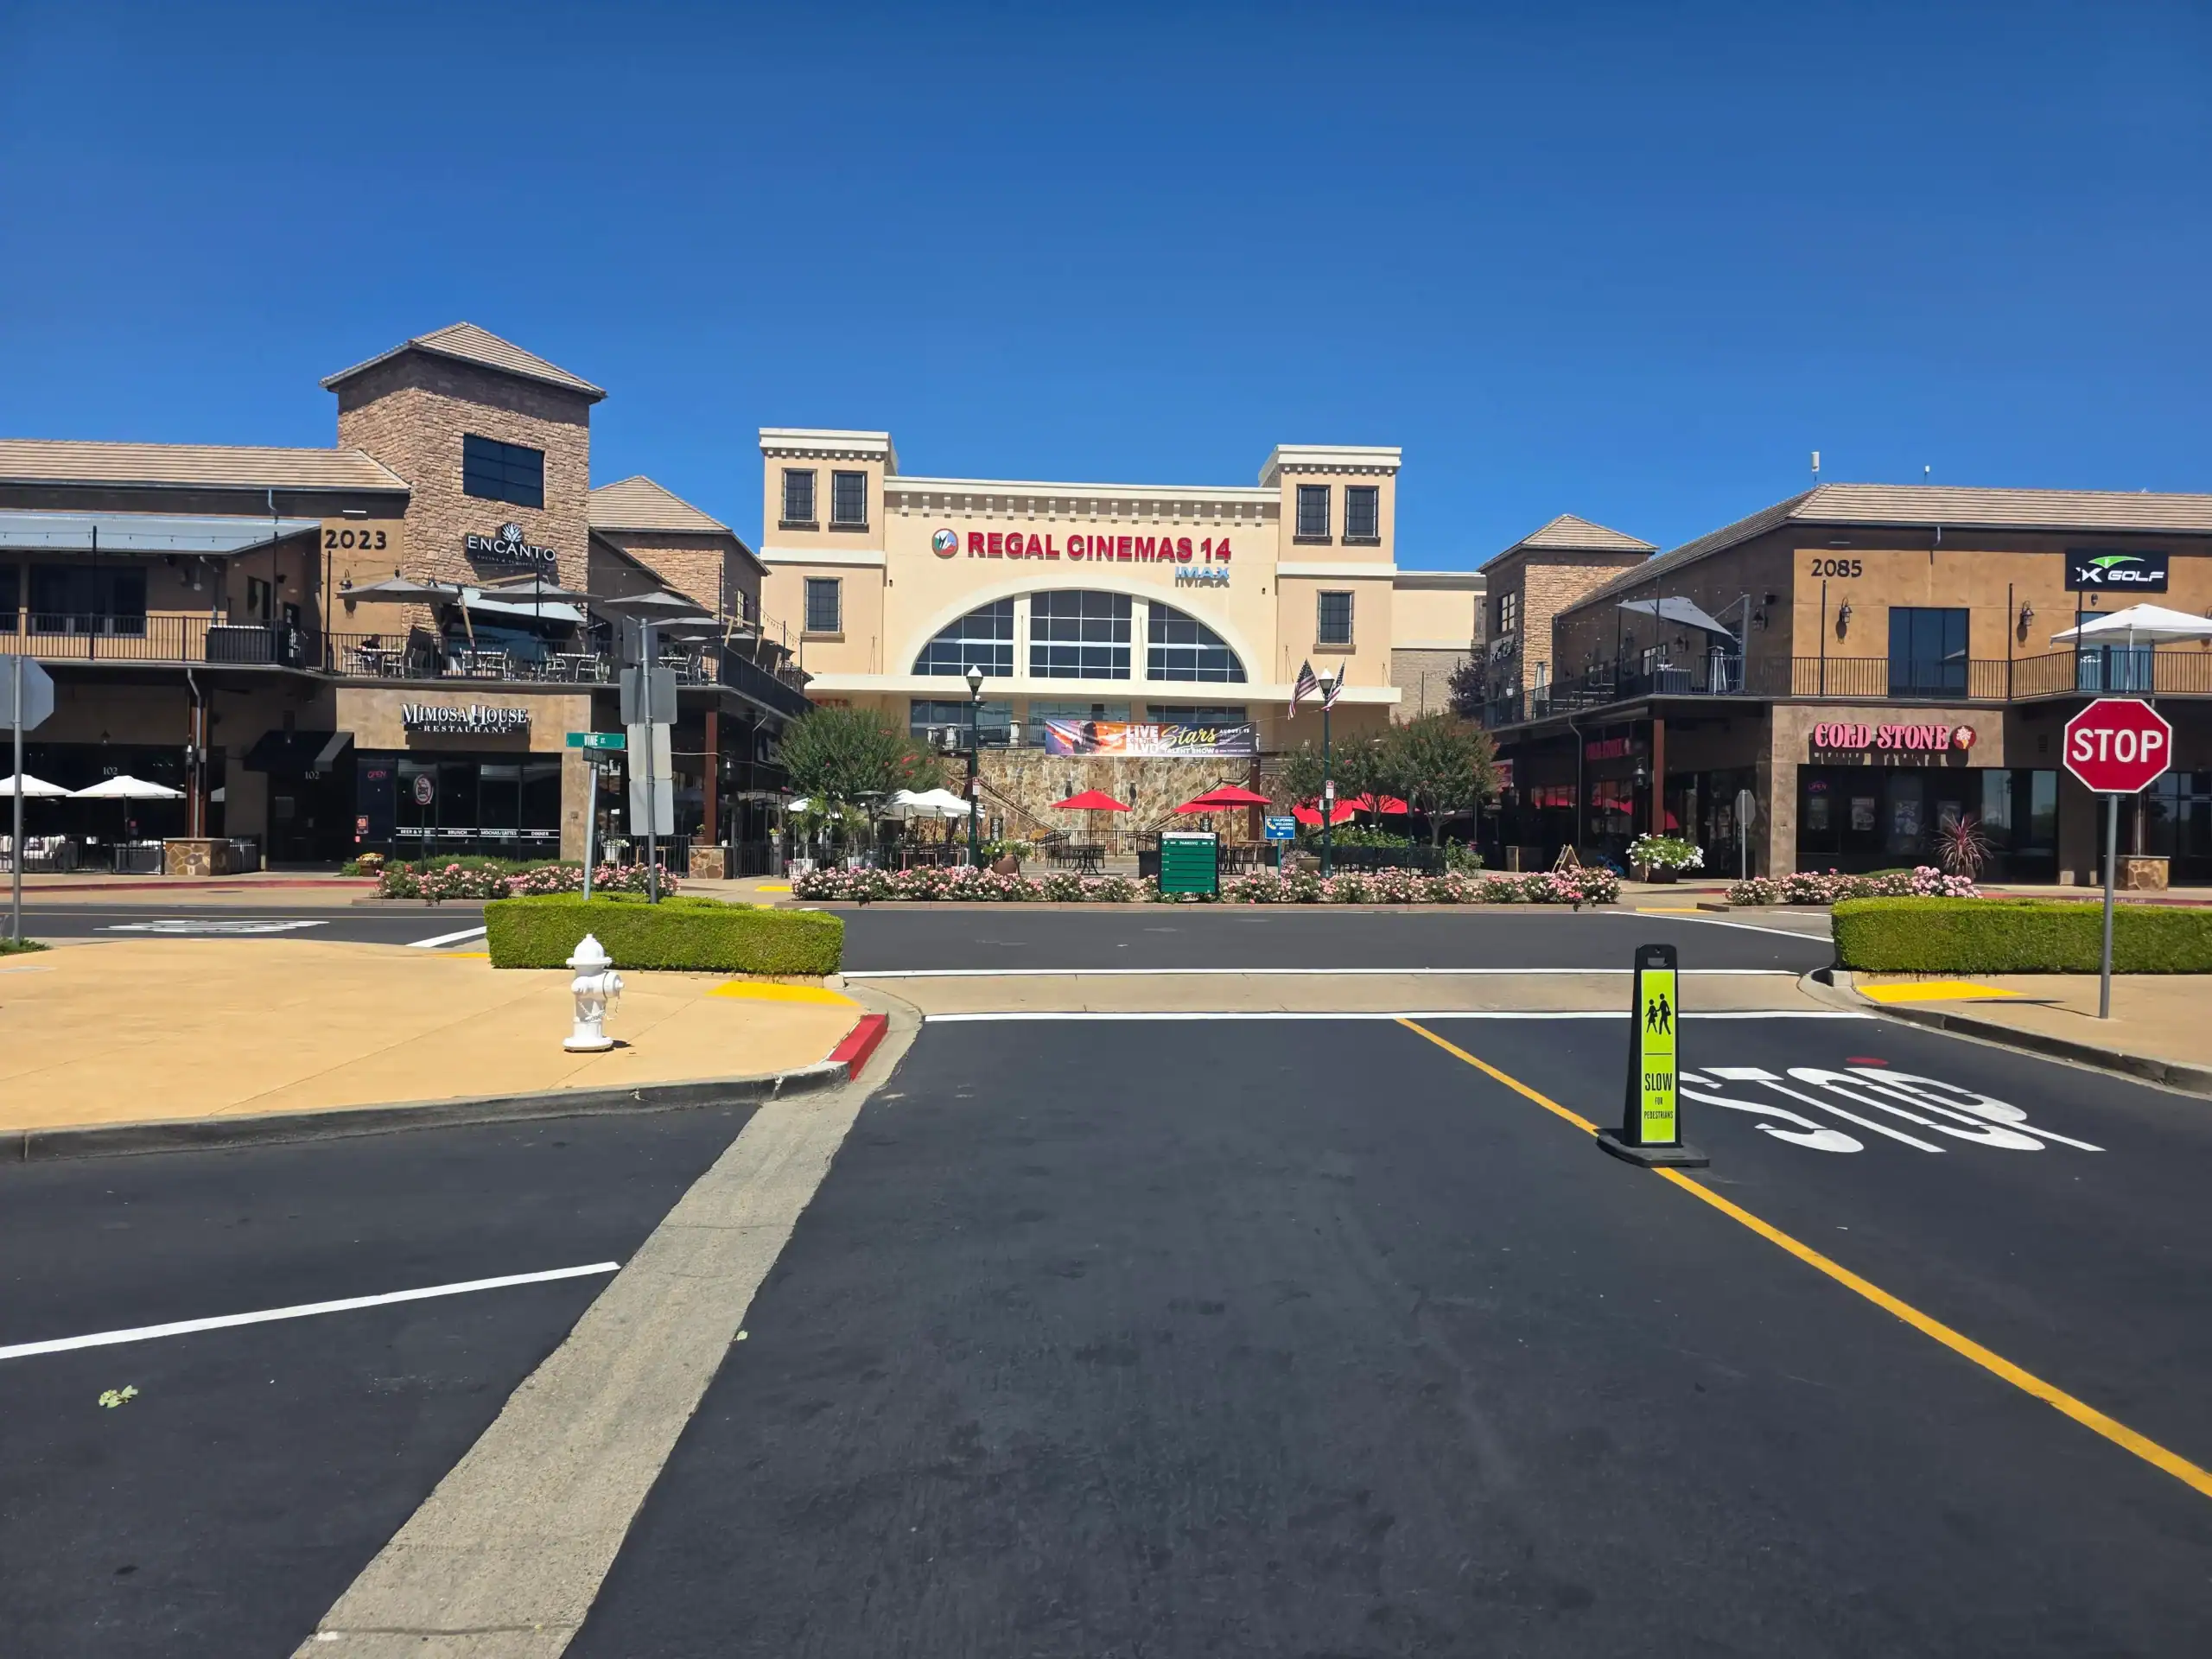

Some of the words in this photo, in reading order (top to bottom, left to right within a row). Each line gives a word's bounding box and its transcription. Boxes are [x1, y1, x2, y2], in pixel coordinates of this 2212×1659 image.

[325, 529, 386, 550] 2023
[968, 531, 1060, 560] REGAL
[1067, 534, 1192, 563] CINEMAS
[1200, 537, 1231, 563] 14
[467, 536, 556, 561] ENCANTO
[1175, 566, 1230, 578] IMAX
[1811, 559, 1862, 578] 2085
[2108, 569, 2164, 582] GOLF
[400, 703, 467, 724] MIMOSA
[469, 704, 527, 727] HOUSE
[1127, 725, 1158, 739] LIVE
[1160, 725, 1217, 750] Stars
[1815, 722, 1872, 748] COLD
[1877, 723, 1950, 750] STONE
[583, 734, 598, 747] VINE
[2072, 728, 2164, 763] STOP
[103, 766, 118, 775] 102
[305, 770, 320, 779] 102
[367, 771, 387, 779] OPEN
[1644, 1072, 1673, 1092] SLOW
[1655, 1096, 1663, 1106] FOR
[1643, 1110, 1674, 1120] PEDESTRIANS
